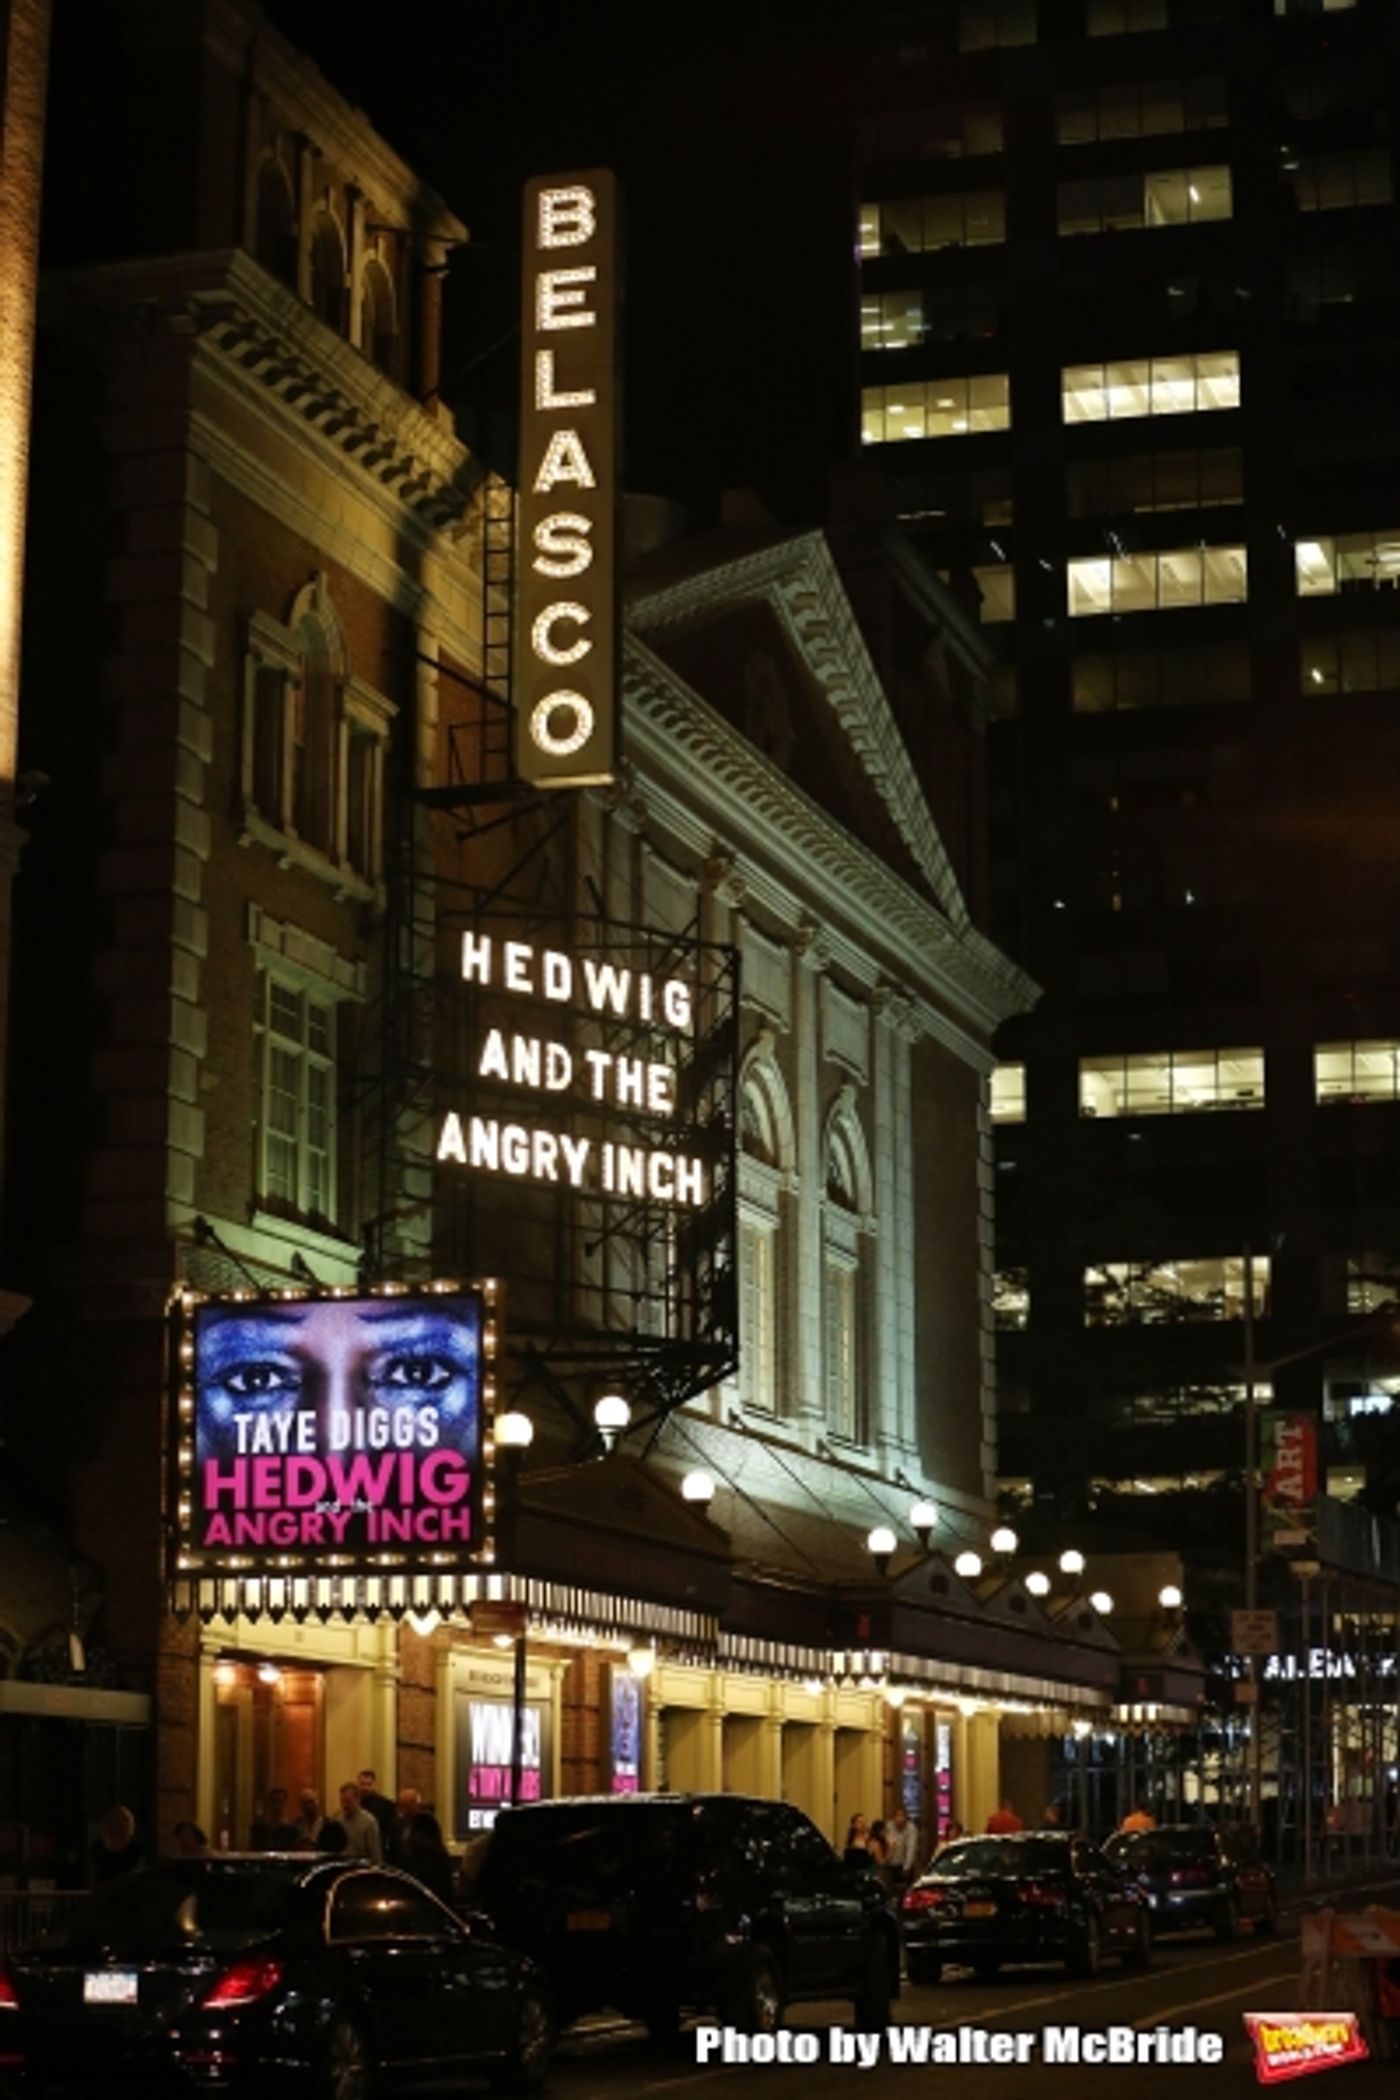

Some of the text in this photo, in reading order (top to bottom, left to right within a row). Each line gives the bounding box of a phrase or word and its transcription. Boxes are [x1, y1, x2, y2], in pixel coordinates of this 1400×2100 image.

[529, 184, 597, 758] BELASCO
[461, 930, 691, 1028] HEDWIG
[478, 1028, 674, 1113] AND THE
[437, 1111, 702, 1205] ANGRY INCH
[234, 1405, 440, 1454] TAYE DIGGS
[203, 1449, 471, 1510] HEDWIG
[203, 1507, 472, 1546] ANGRY INCH
